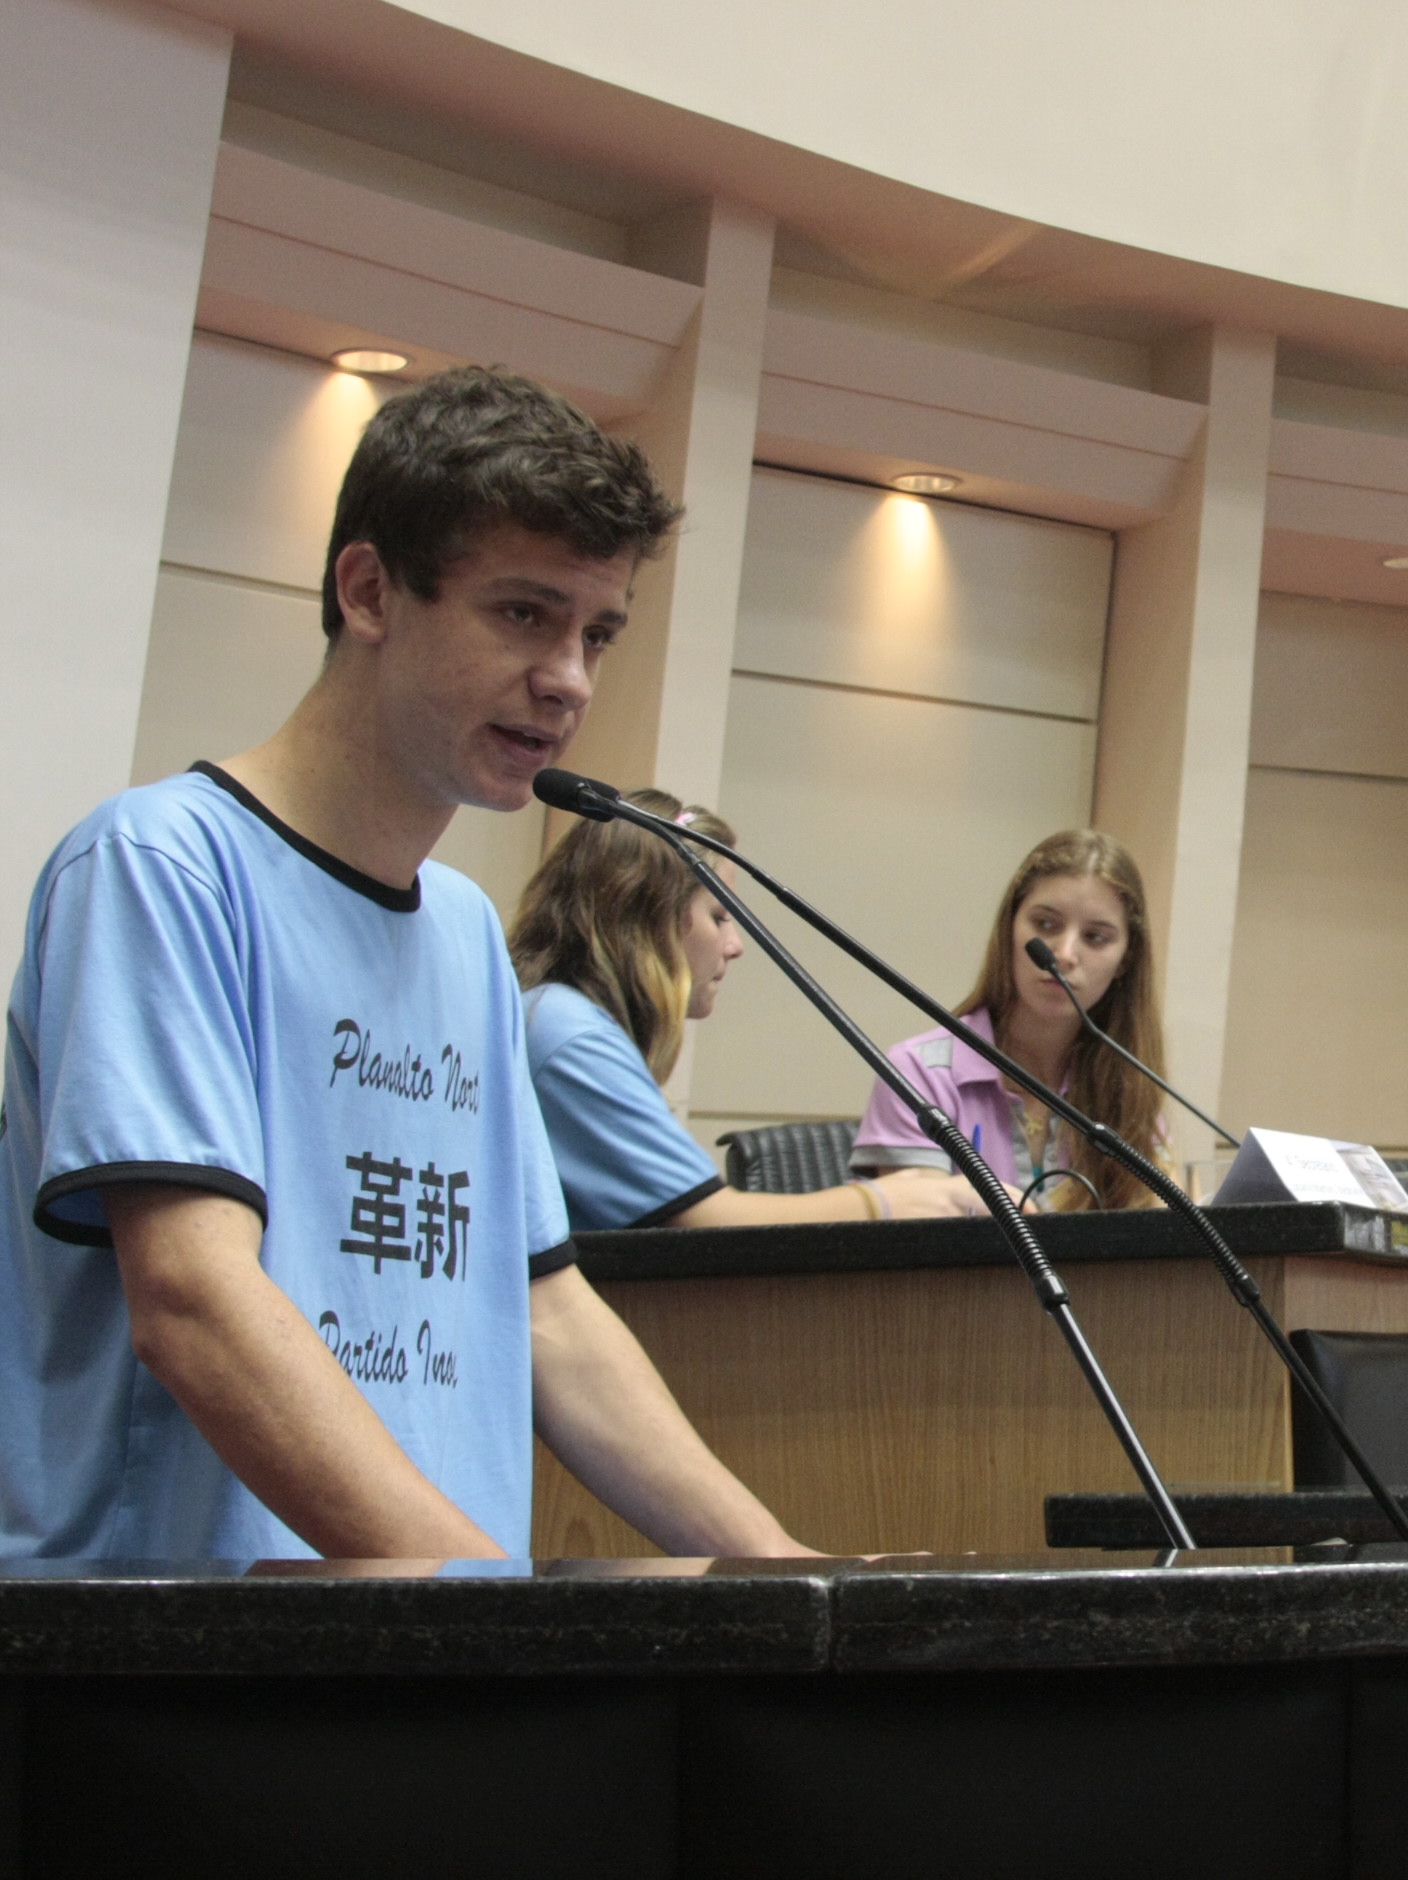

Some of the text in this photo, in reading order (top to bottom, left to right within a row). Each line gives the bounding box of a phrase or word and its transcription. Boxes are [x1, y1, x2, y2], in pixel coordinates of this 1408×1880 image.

[330, 1018, 481, 1115] Planalto Nort
[340, 1151, 470, 1282] 革新
[319, 1310, 408, 1384] Partido
